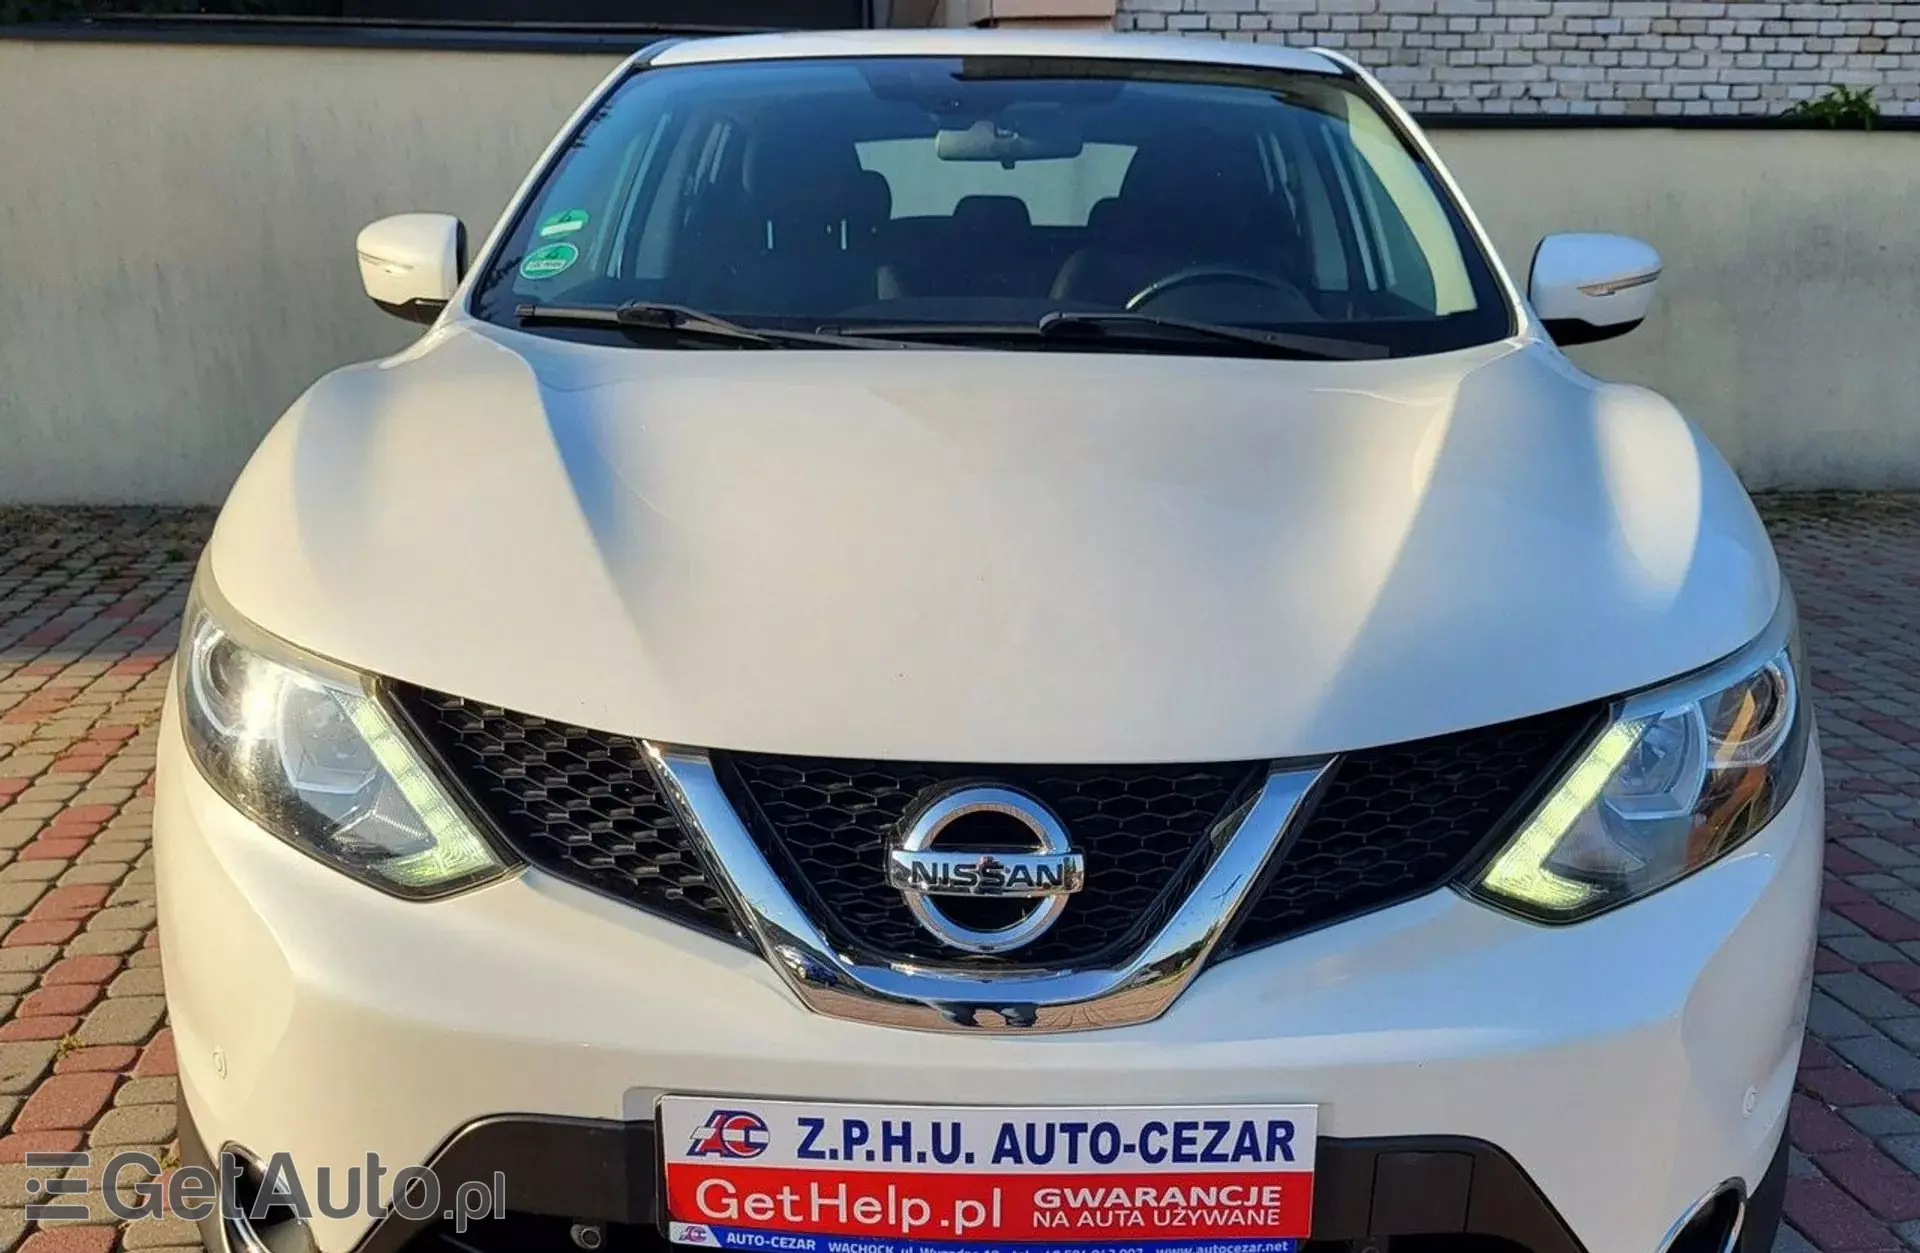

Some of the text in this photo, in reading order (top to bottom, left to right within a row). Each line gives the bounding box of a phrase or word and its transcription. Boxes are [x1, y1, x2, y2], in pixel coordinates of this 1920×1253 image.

[911, 861, 1064, 888] NISSAN
[796, 1117, 1296, 1165] Z.P.H.U. AUTO-CEZAR
[695, 1178, 1002, 1236] GetHelp.pl
[1033, 1186, 1282, 1208] GWARANCJE
[1033, 1206, 1281, 1228] NA AUTA UŻYWANE
[726, 1231, 817, 1251] AUTO-CEZAR
